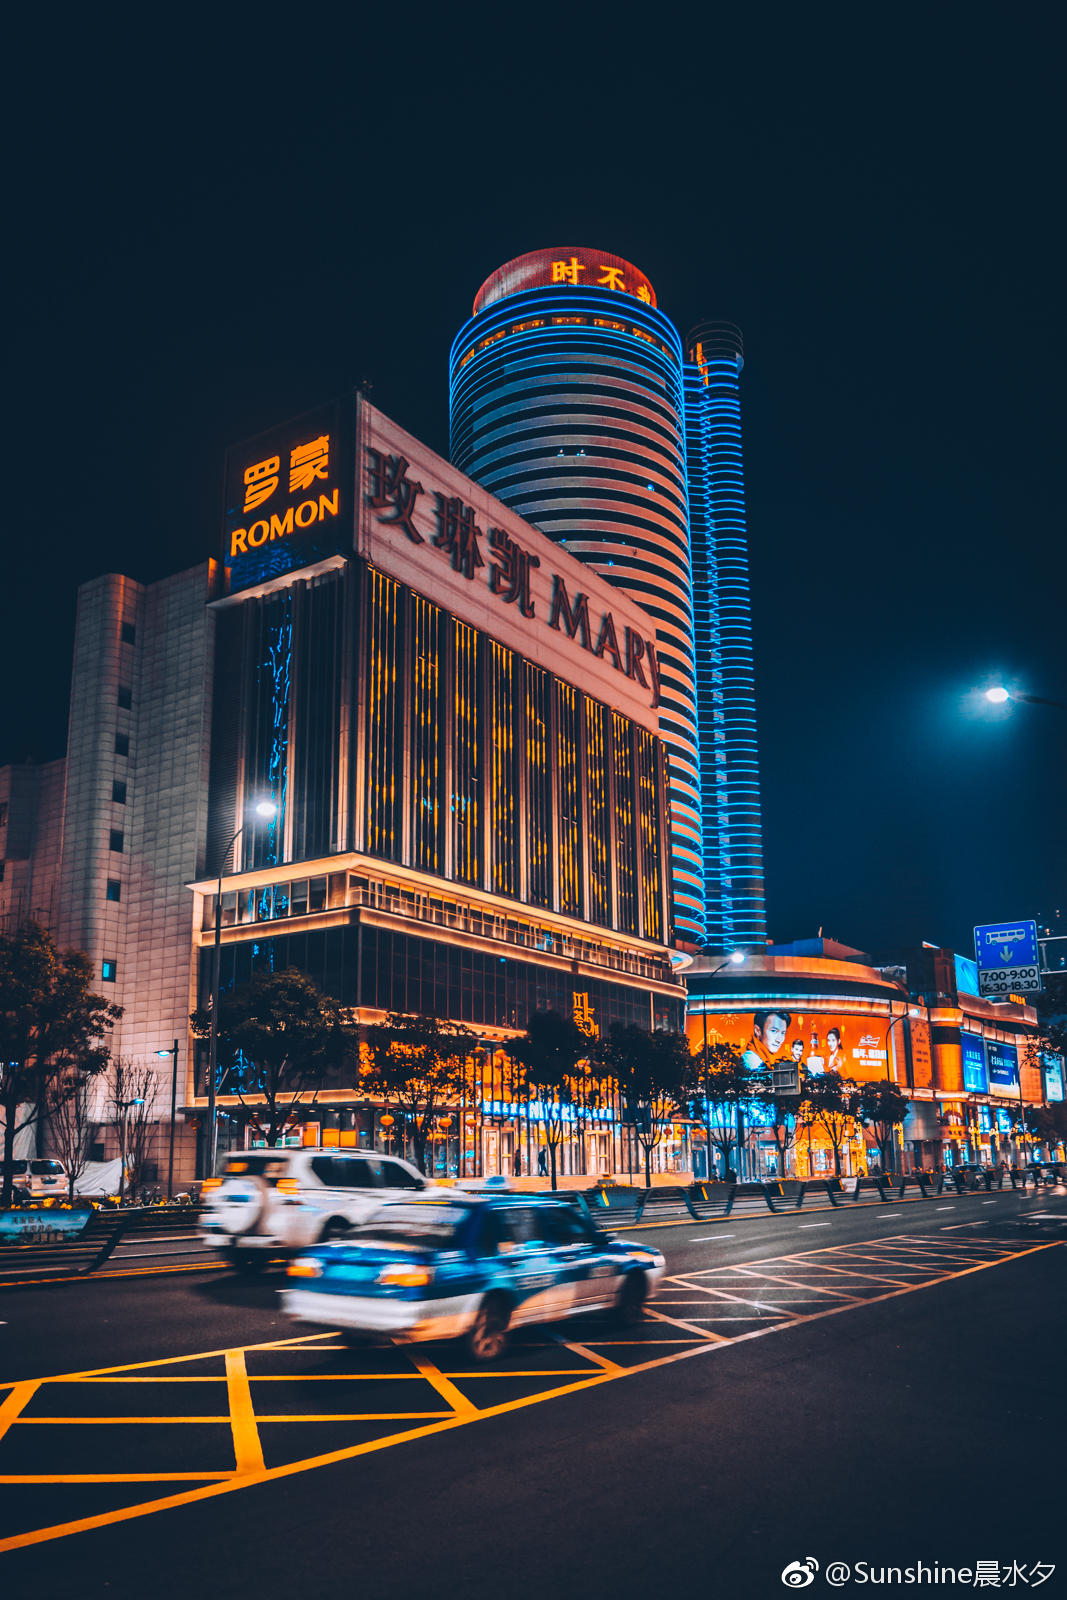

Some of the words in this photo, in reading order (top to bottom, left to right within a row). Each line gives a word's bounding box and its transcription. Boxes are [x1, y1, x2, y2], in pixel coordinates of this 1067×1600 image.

[243, 434, 329, 514] 罗蒙
[230, 488, 339, 557] ROMON
[367, 447, 541, 618] 玫琳凯
[547, 572, 661, 709] MARY
[981, 968, 1036, 982] 7:00-9:00
[981, 980, 1038, 993] 16:30-18:30
